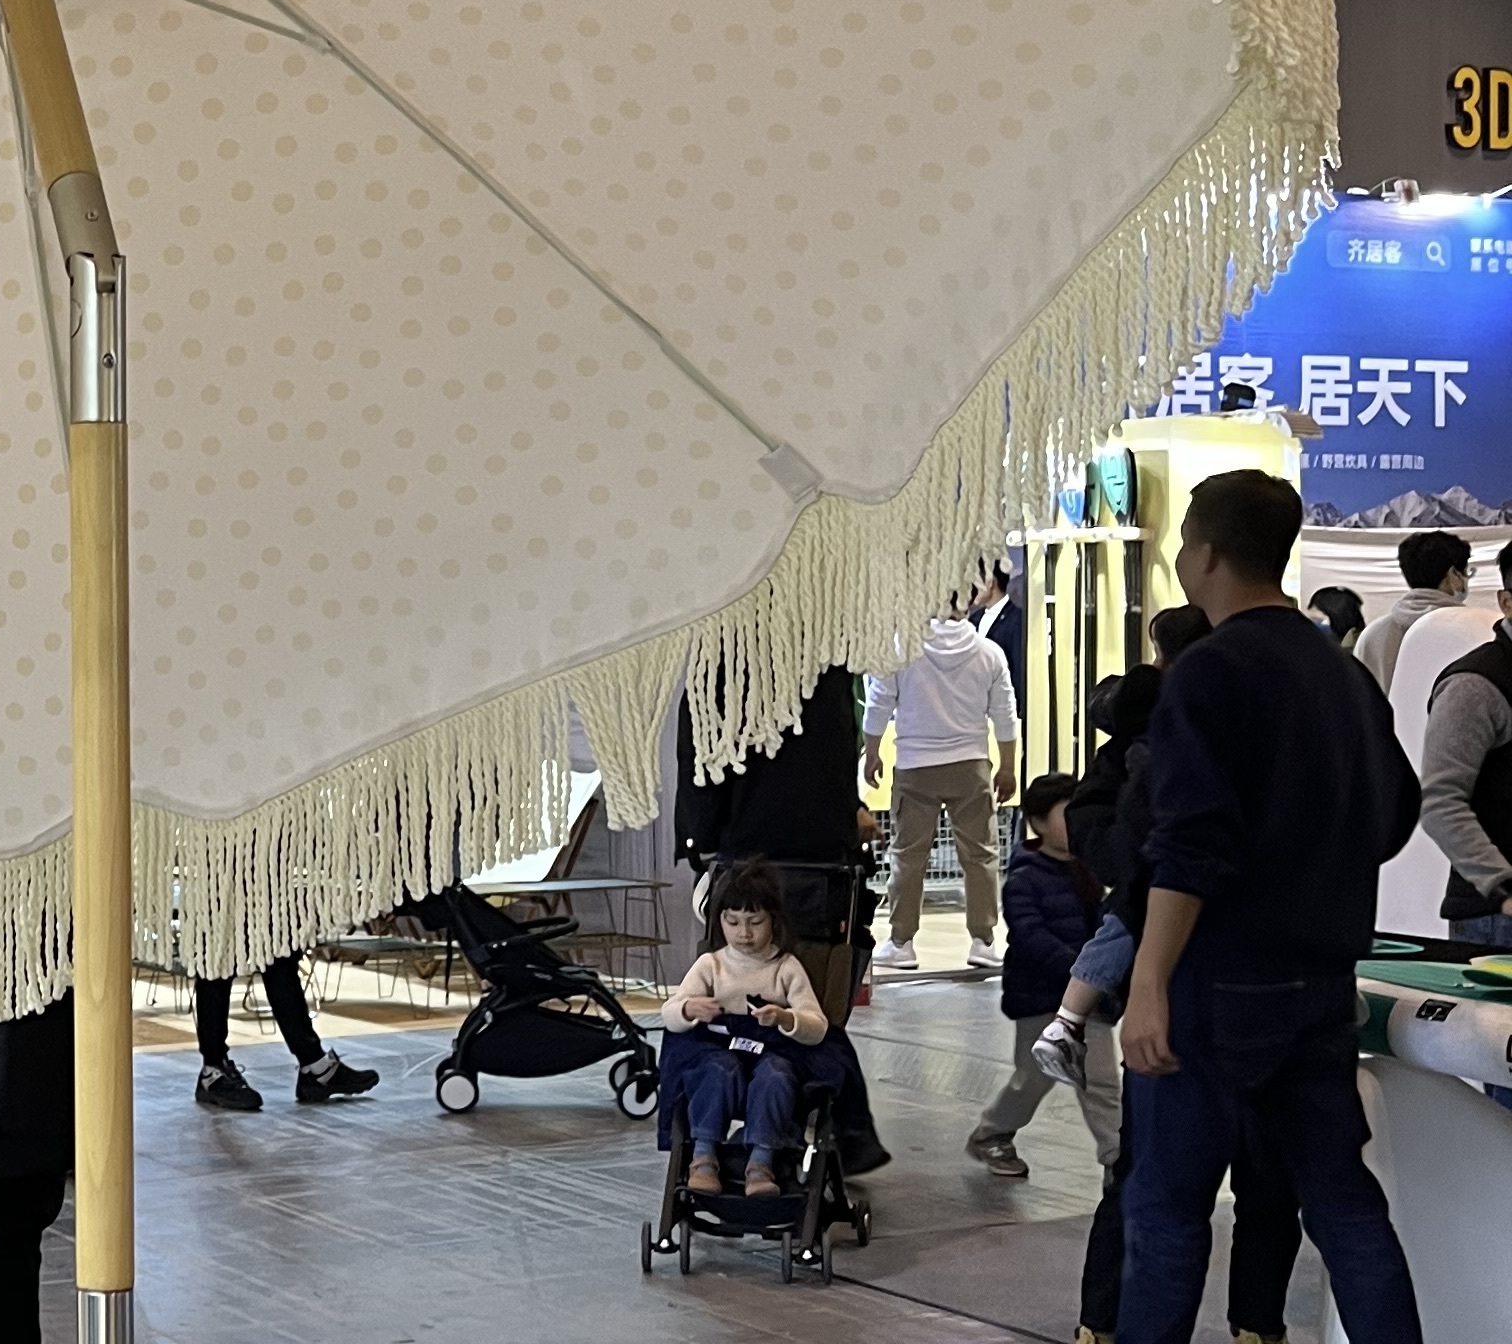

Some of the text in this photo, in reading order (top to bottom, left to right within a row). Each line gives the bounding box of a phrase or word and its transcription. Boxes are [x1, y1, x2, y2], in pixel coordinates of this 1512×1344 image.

[1451, 65, 1512, 150] 3D
[1348, 239, 1402, 263] 齐居客
[1299, 355, 1469, 427] 居天下
